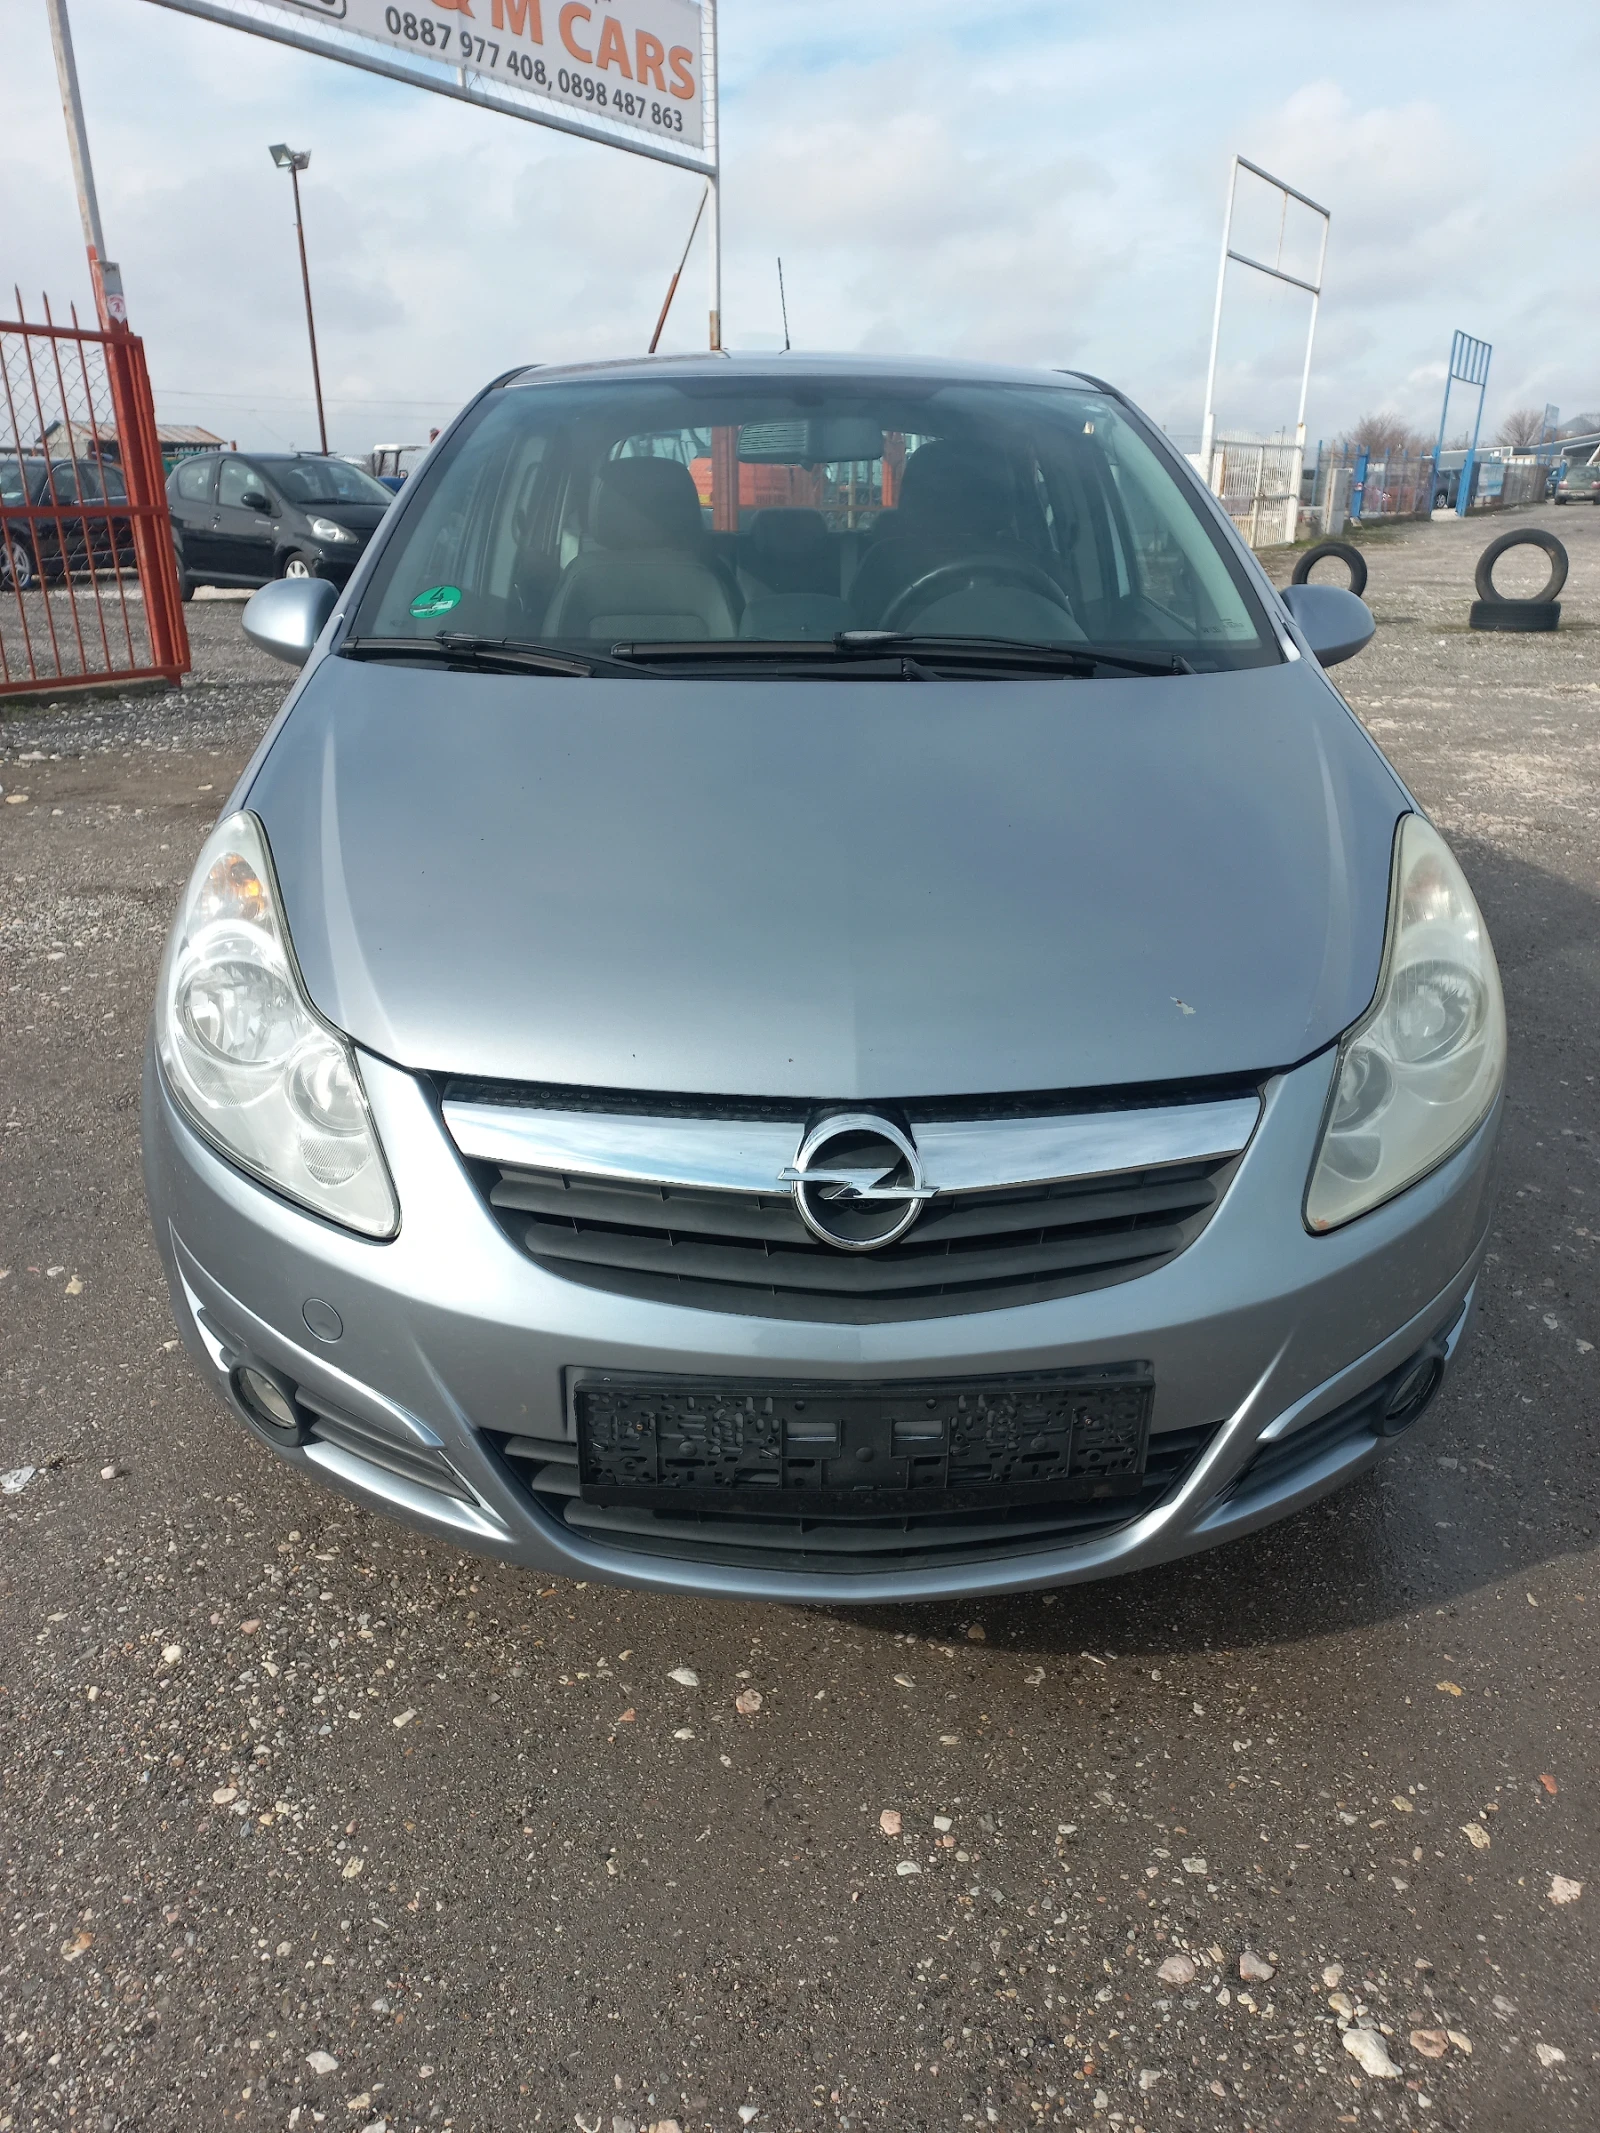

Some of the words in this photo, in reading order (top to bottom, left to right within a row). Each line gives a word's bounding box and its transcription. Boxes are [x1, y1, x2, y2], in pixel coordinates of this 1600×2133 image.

[385, 5, 452, 50] 0887
[459, 30, 500, 68] 977
[506, 50, 553, 92] 408,
[557, 67, 608, 107] 0898
[612, 88, 646, 119] 487
[651, 102, 683, 132] 863
[558, 1, 695, 100] CARS
[429, 587, 445, 602] 4
